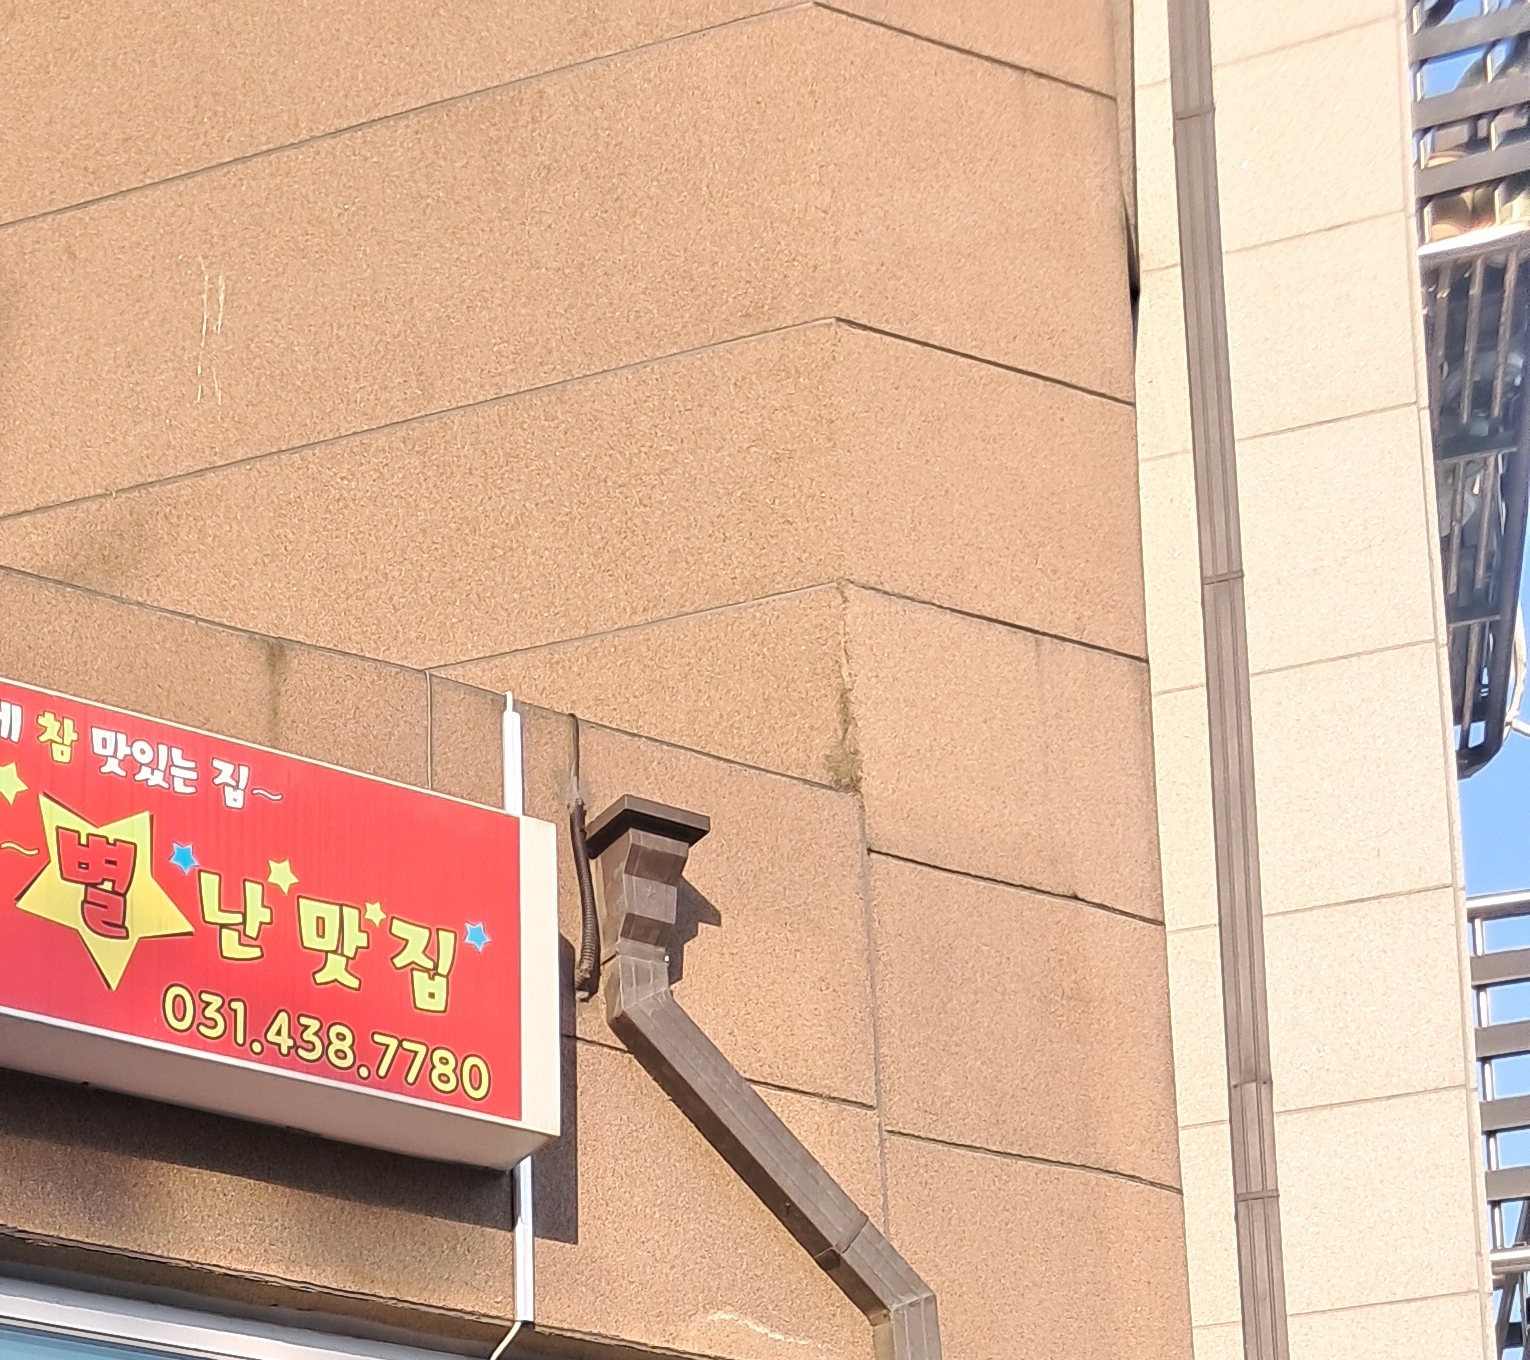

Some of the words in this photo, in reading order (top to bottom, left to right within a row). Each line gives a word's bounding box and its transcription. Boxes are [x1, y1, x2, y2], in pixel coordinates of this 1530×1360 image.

[36, 711, 79, 764] 참
[90, 725, 199, 795] 맛있는
[162, 983, 492, 1102] 031.438.7780
